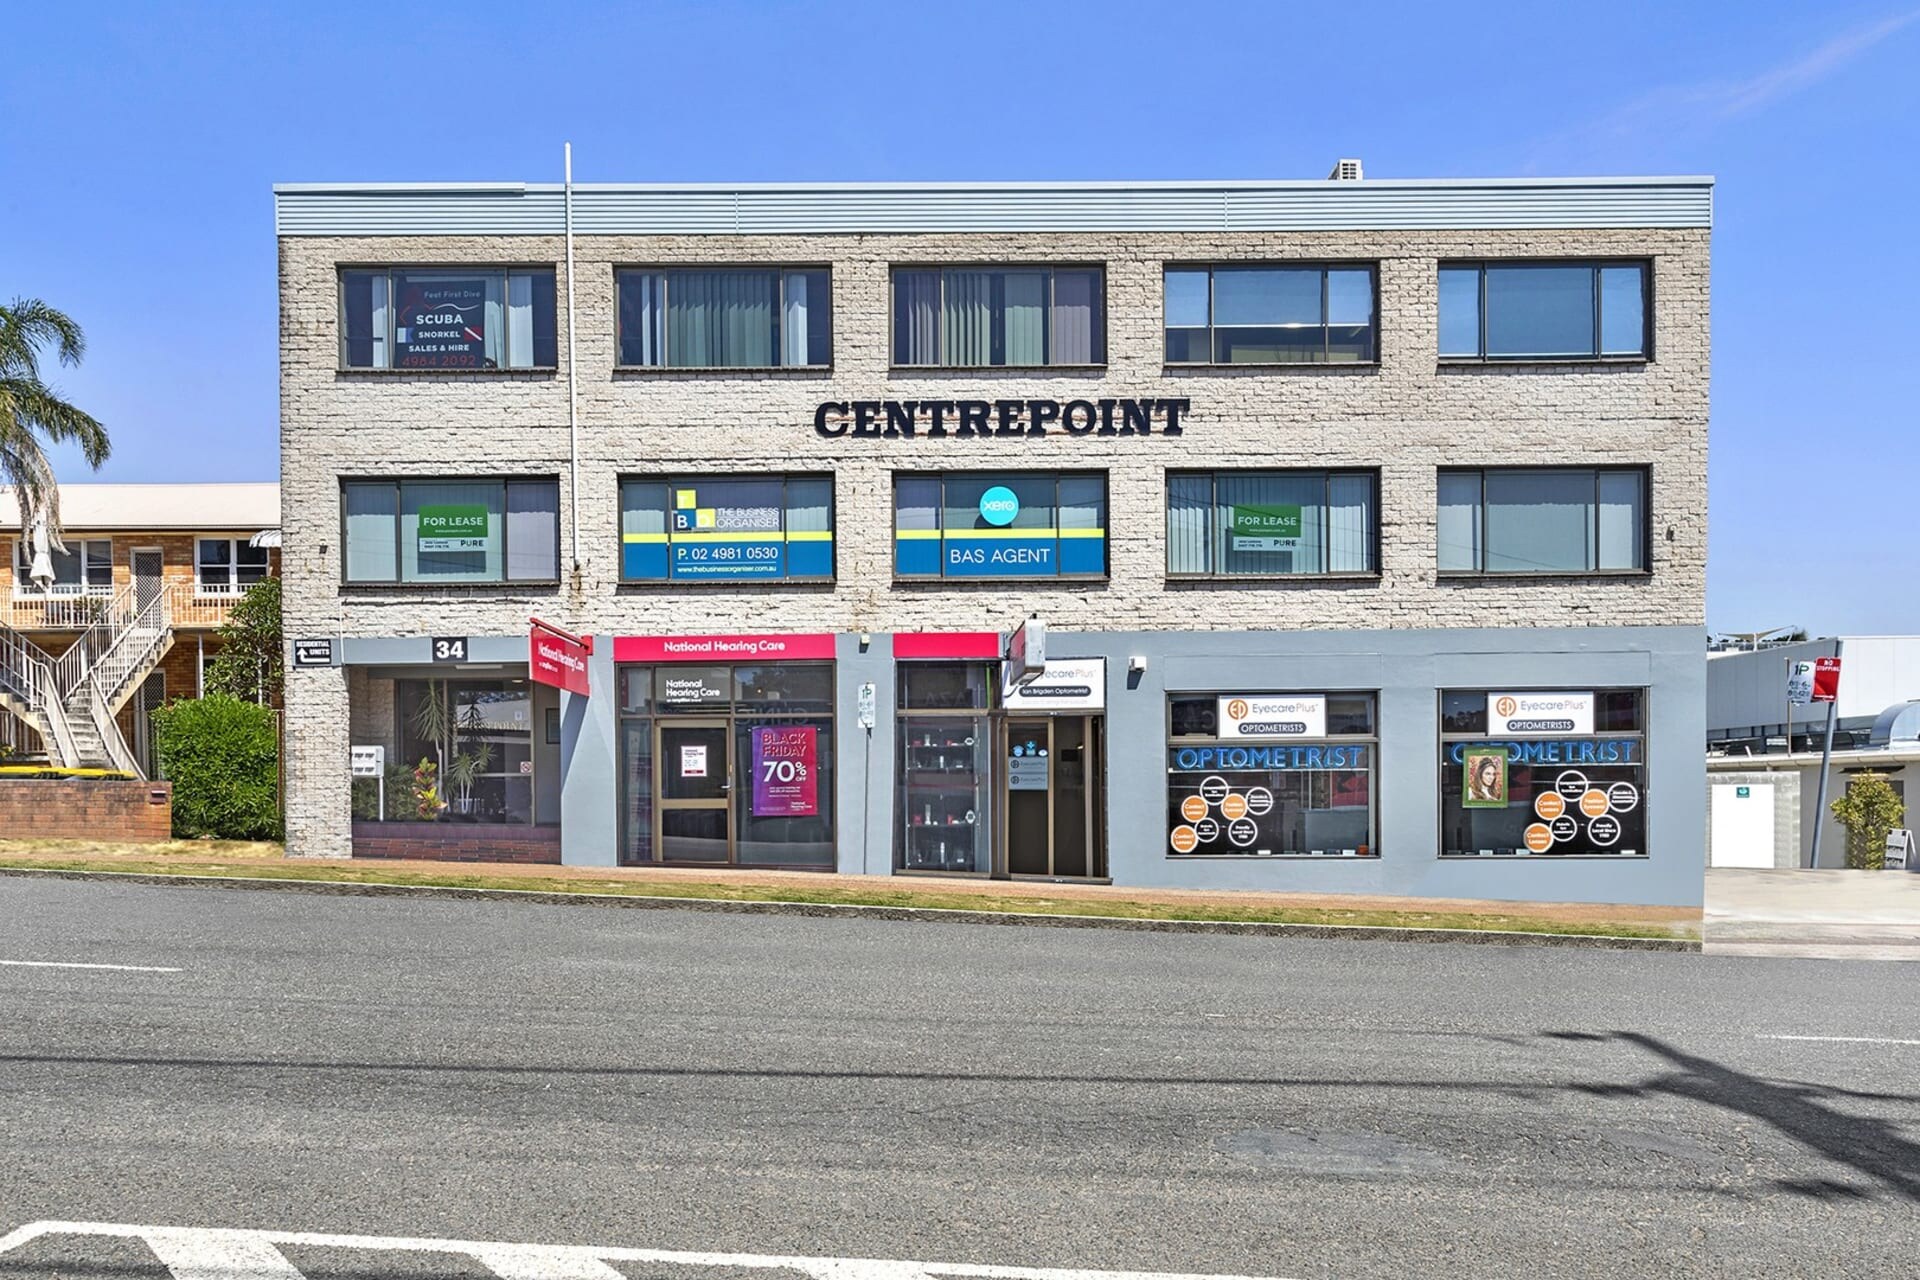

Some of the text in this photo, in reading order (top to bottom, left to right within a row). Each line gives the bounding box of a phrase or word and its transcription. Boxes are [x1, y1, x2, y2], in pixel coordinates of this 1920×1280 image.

[416, 314, 464, 325] SCUBA
[418, 331, 460, 339] SNORKEL
[448, 344, 470, 352] HIRE
[442, 355, 476, 366] 2092
[814, 398, 1191, 438] CENTREPOINT
[717, 507, 780, 517] THE BUSINESS
[984, 500, 1016, 512] xero
[423, 517, 484, 526] FOR LEASE
[677, 514, 688, 529] B
[716, 517, 780, 529] ORGANISER
[1238, 516, 1297, 526] FOR LEASE
[460, 539, 485, 547] PURE
[1273, 539, 1297, 547] PURE
[677, 547, 779, 560] P. 02 4981 0530
[950, 548, 1051, 564] BAS AGENT
[436, 640, 464, 659] 34
[664, 640, 786, 654] National Hearing Care
[1795, 664, 1810, 676] 1P
[665, 679, 703, 688] National
[665, 687, 721, 699] Hearing Care
[1241, 722, 1304, 733] OPTOMETRISTS
[1508, 720, 1573, 730] OPTOMETRISTS
[763, 732, 807, 746] BLACK
[763, 745, 807, 758] FRIDAY
[1176, 745, 1363, 769] OPTOMETRIST
[762, 760, 807, 783] 70%
